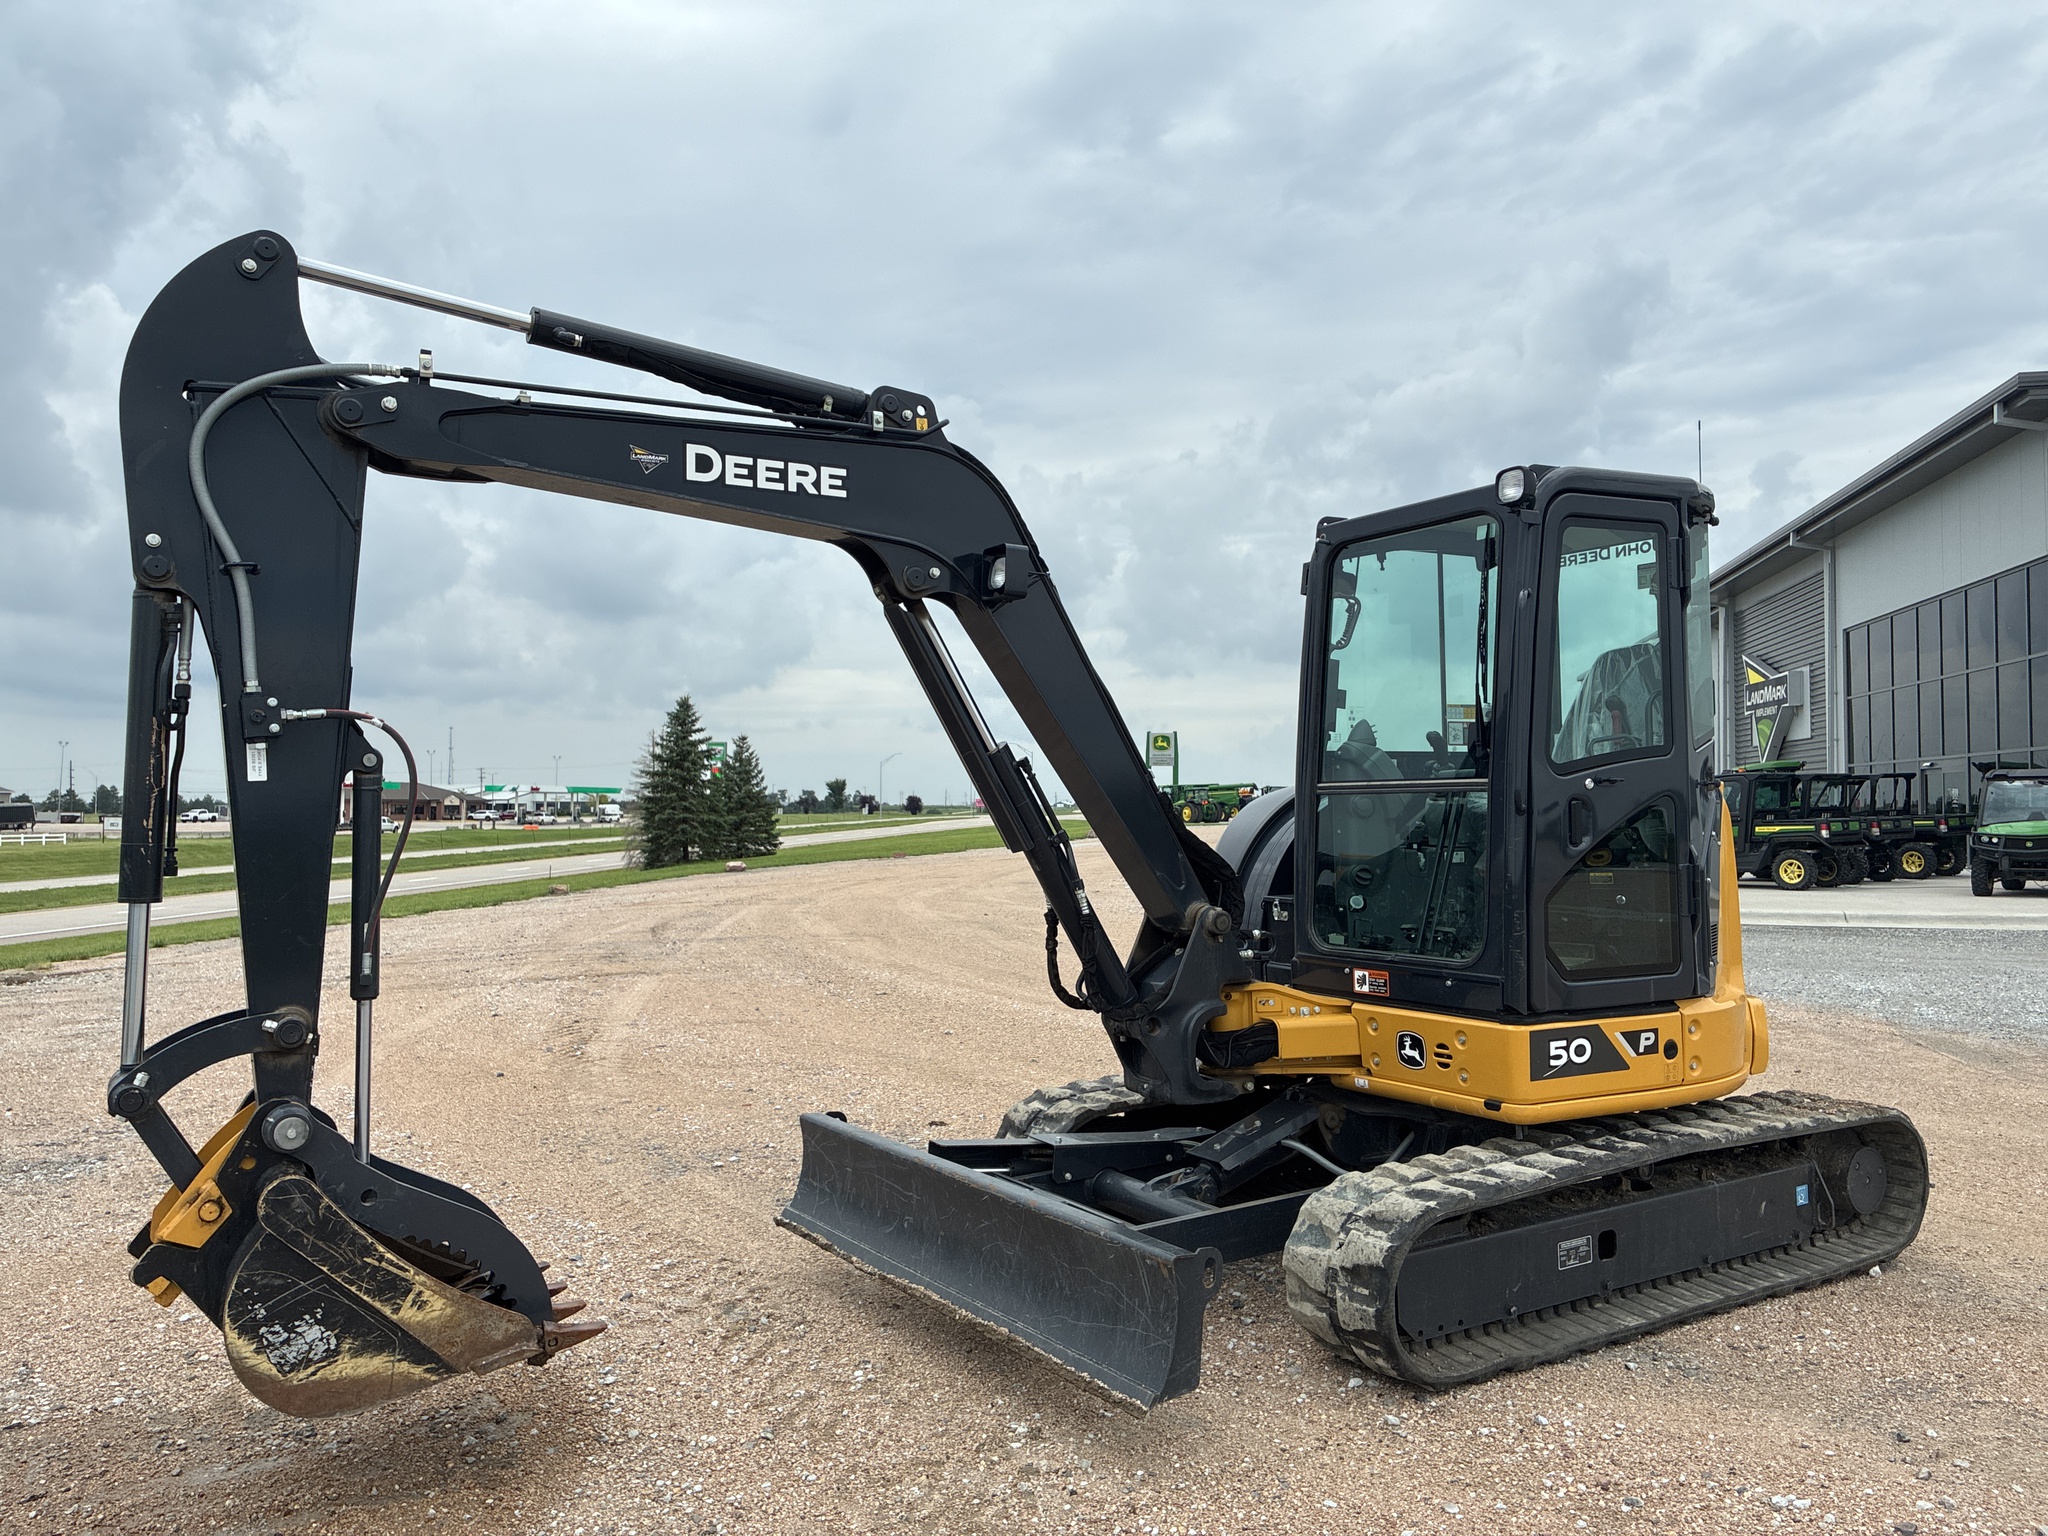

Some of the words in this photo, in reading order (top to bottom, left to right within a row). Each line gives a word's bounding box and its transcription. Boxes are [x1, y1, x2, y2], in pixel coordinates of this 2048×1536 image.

[686, 443, 848, 498] DEERE
[1746, 683, 1787, 706] LANDMARK
[1755, 705, 1778, 718] IMPLEMENT
[1549, 1037, 1592, 1068] 50
[1638, 1031, 1656, 1053] P
